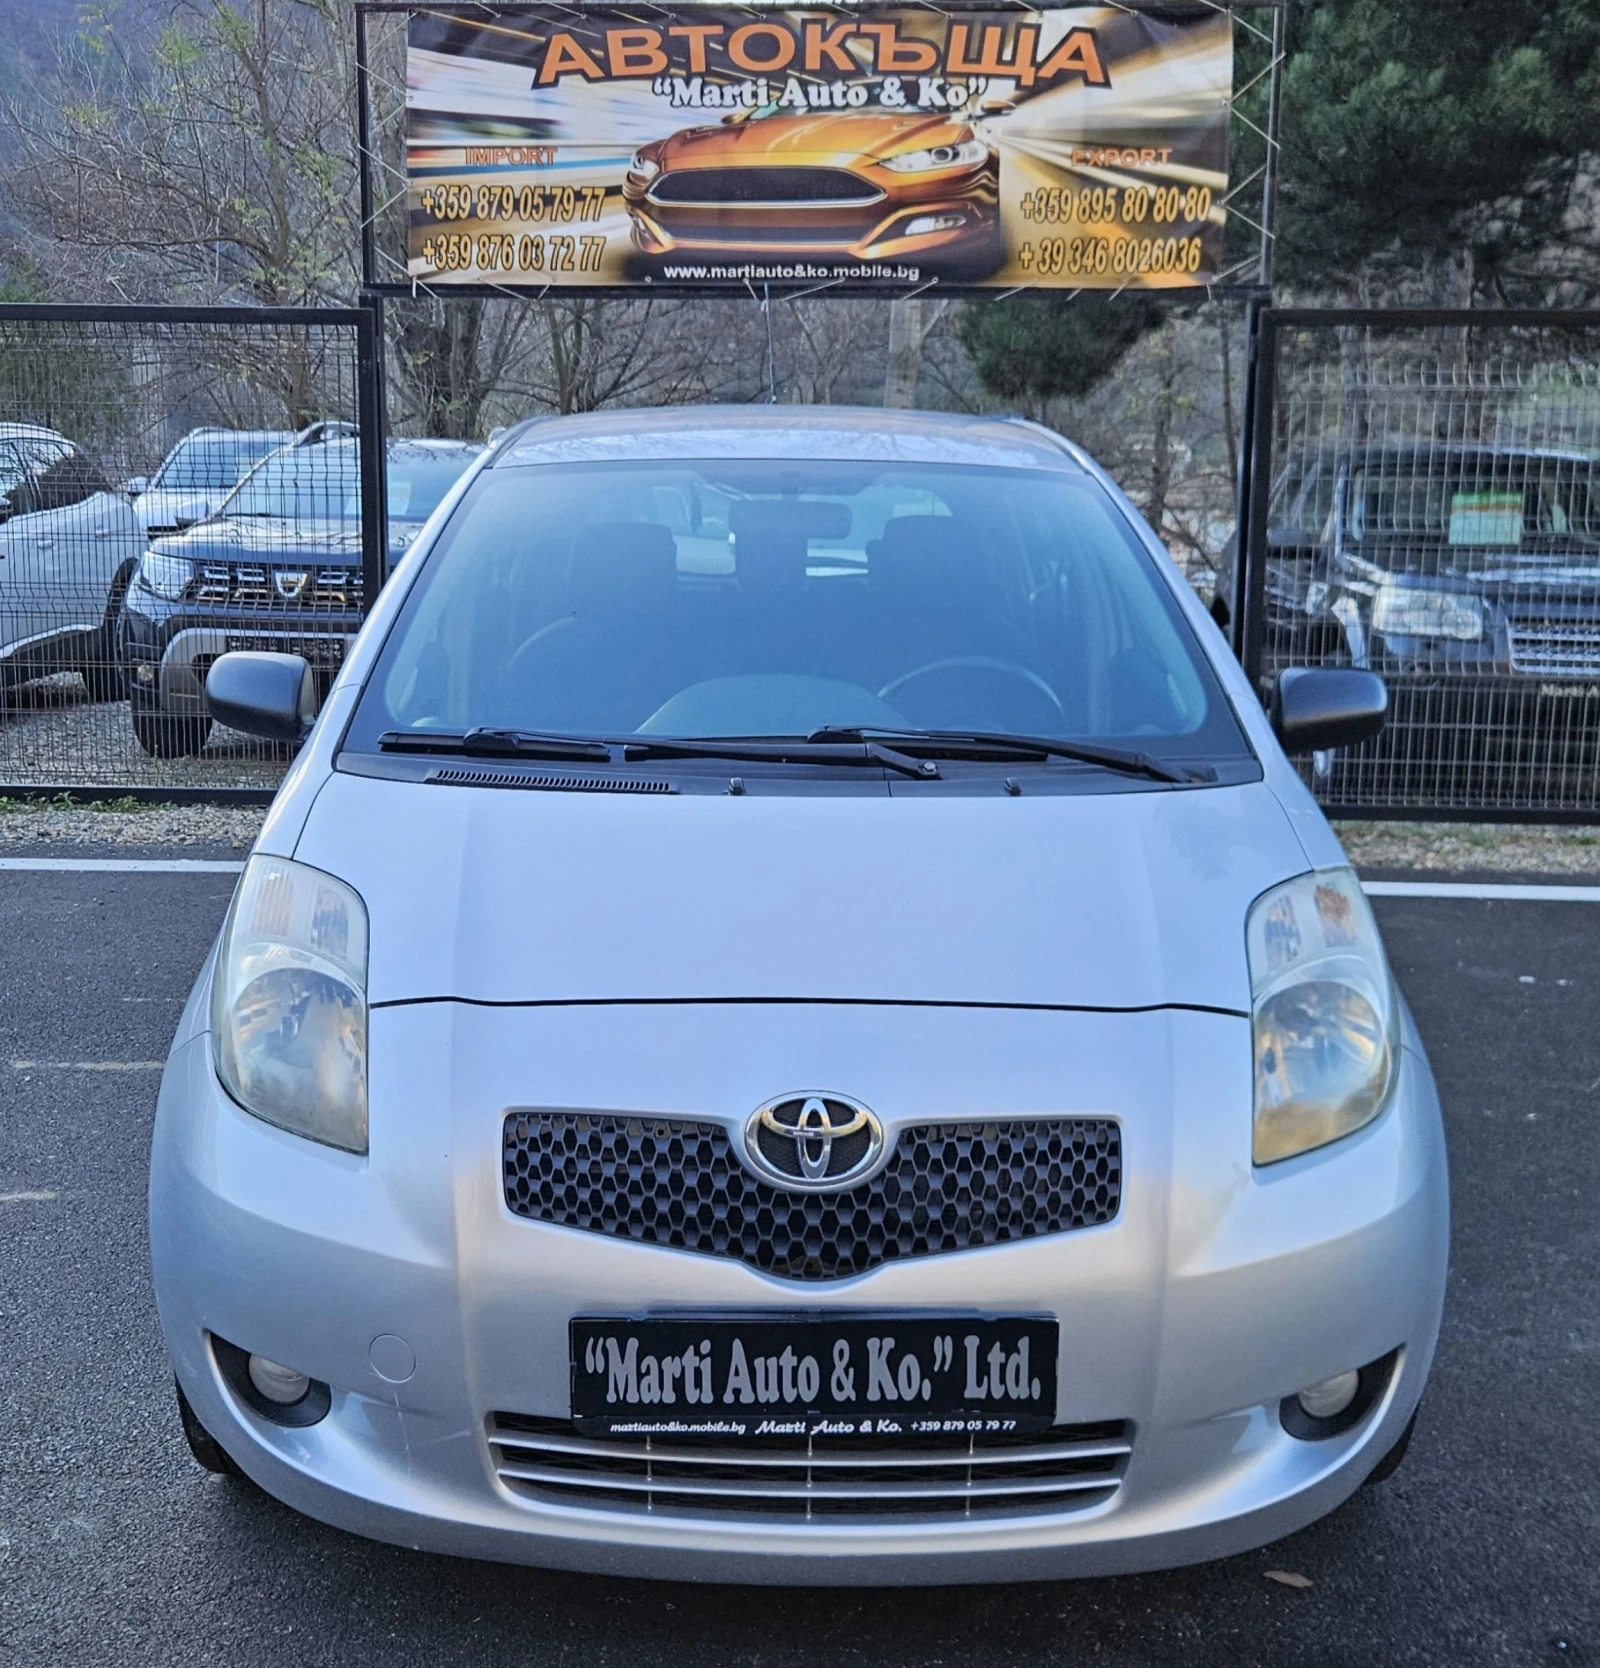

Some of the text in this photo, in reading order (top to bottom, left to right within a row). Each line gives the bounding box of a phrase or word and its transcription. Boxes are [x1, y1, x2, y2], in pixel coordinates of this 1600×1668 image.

[532, 21, 1112, 89] АВТОКЪЩА
[776, 77, 869, 108] Auto
[879, 77, 905, 108] &
[465, 146, 558, 166] IMPORT
[1071, 147, 1173, 167] EXPORT
[422, 184, 606, 222] +359 879 05 79 77
[1020, 186, 1211, 224] +359 895 80 80 80
[422, 234, 606, 271] +359 876 03 72 77
[1037, 237, 1065, 275] 39
[1067, 237, 1109, 275] 346
[1112, 237, 1202, 274] 8026036
[663, 264, 920, 281] www.martiauto&ko.mobile.bg
[723, 1337, 820, 1404] Auto
[830, 1338, 856, 1401] &
[963, 1334, 1042, 1400] Ltd.
[754, 1419, 1017, 1435] Marti Auto & Ko. +359 879 05 79 77
